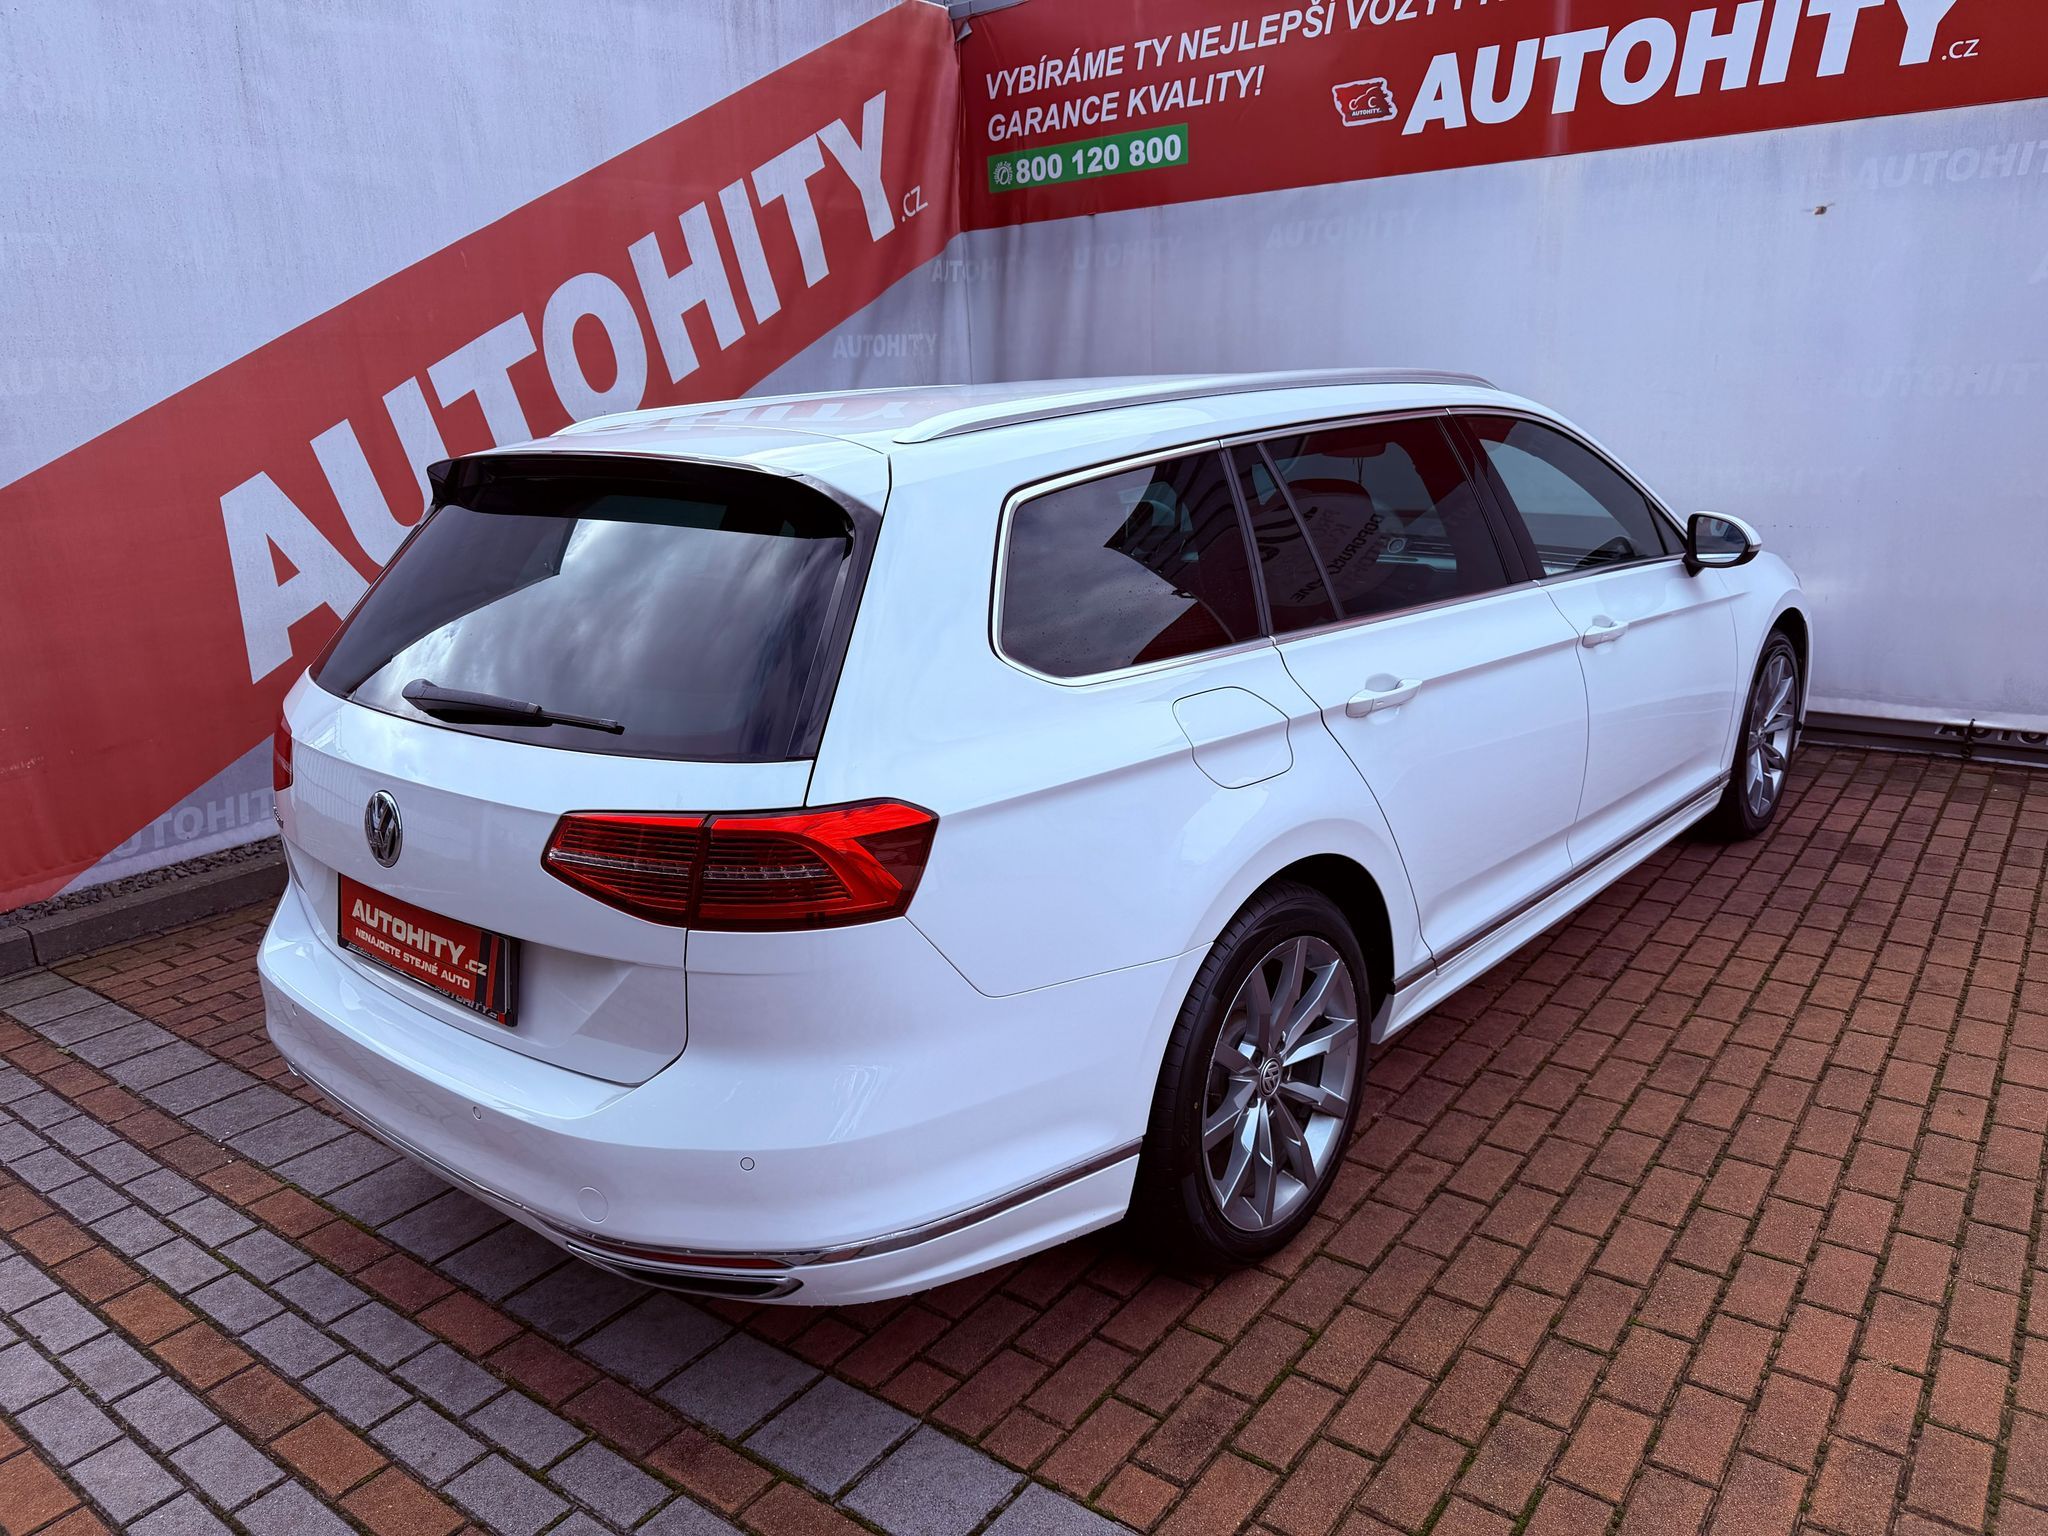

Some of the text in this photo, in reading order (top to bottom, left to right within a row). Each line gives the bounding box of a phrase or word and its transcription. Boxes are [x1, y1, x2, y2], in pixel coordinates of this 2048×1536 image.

[986, 45, 1124, 100] VYBÍRÁME
[1134, 35, 1173, 71] TY
[987, 64, 1266, 142] GARANCE KVALITY!
[1015, 153, 1064, 184] 800
[1071, 143, 1120, 175] 120
[1129, 133, 1182, 167] 800
[355, 927, 401, 960] NENAJDETE
[402, 951, 439, 976] STEJNÉ
[440, 969, 471, 989] AUTO
